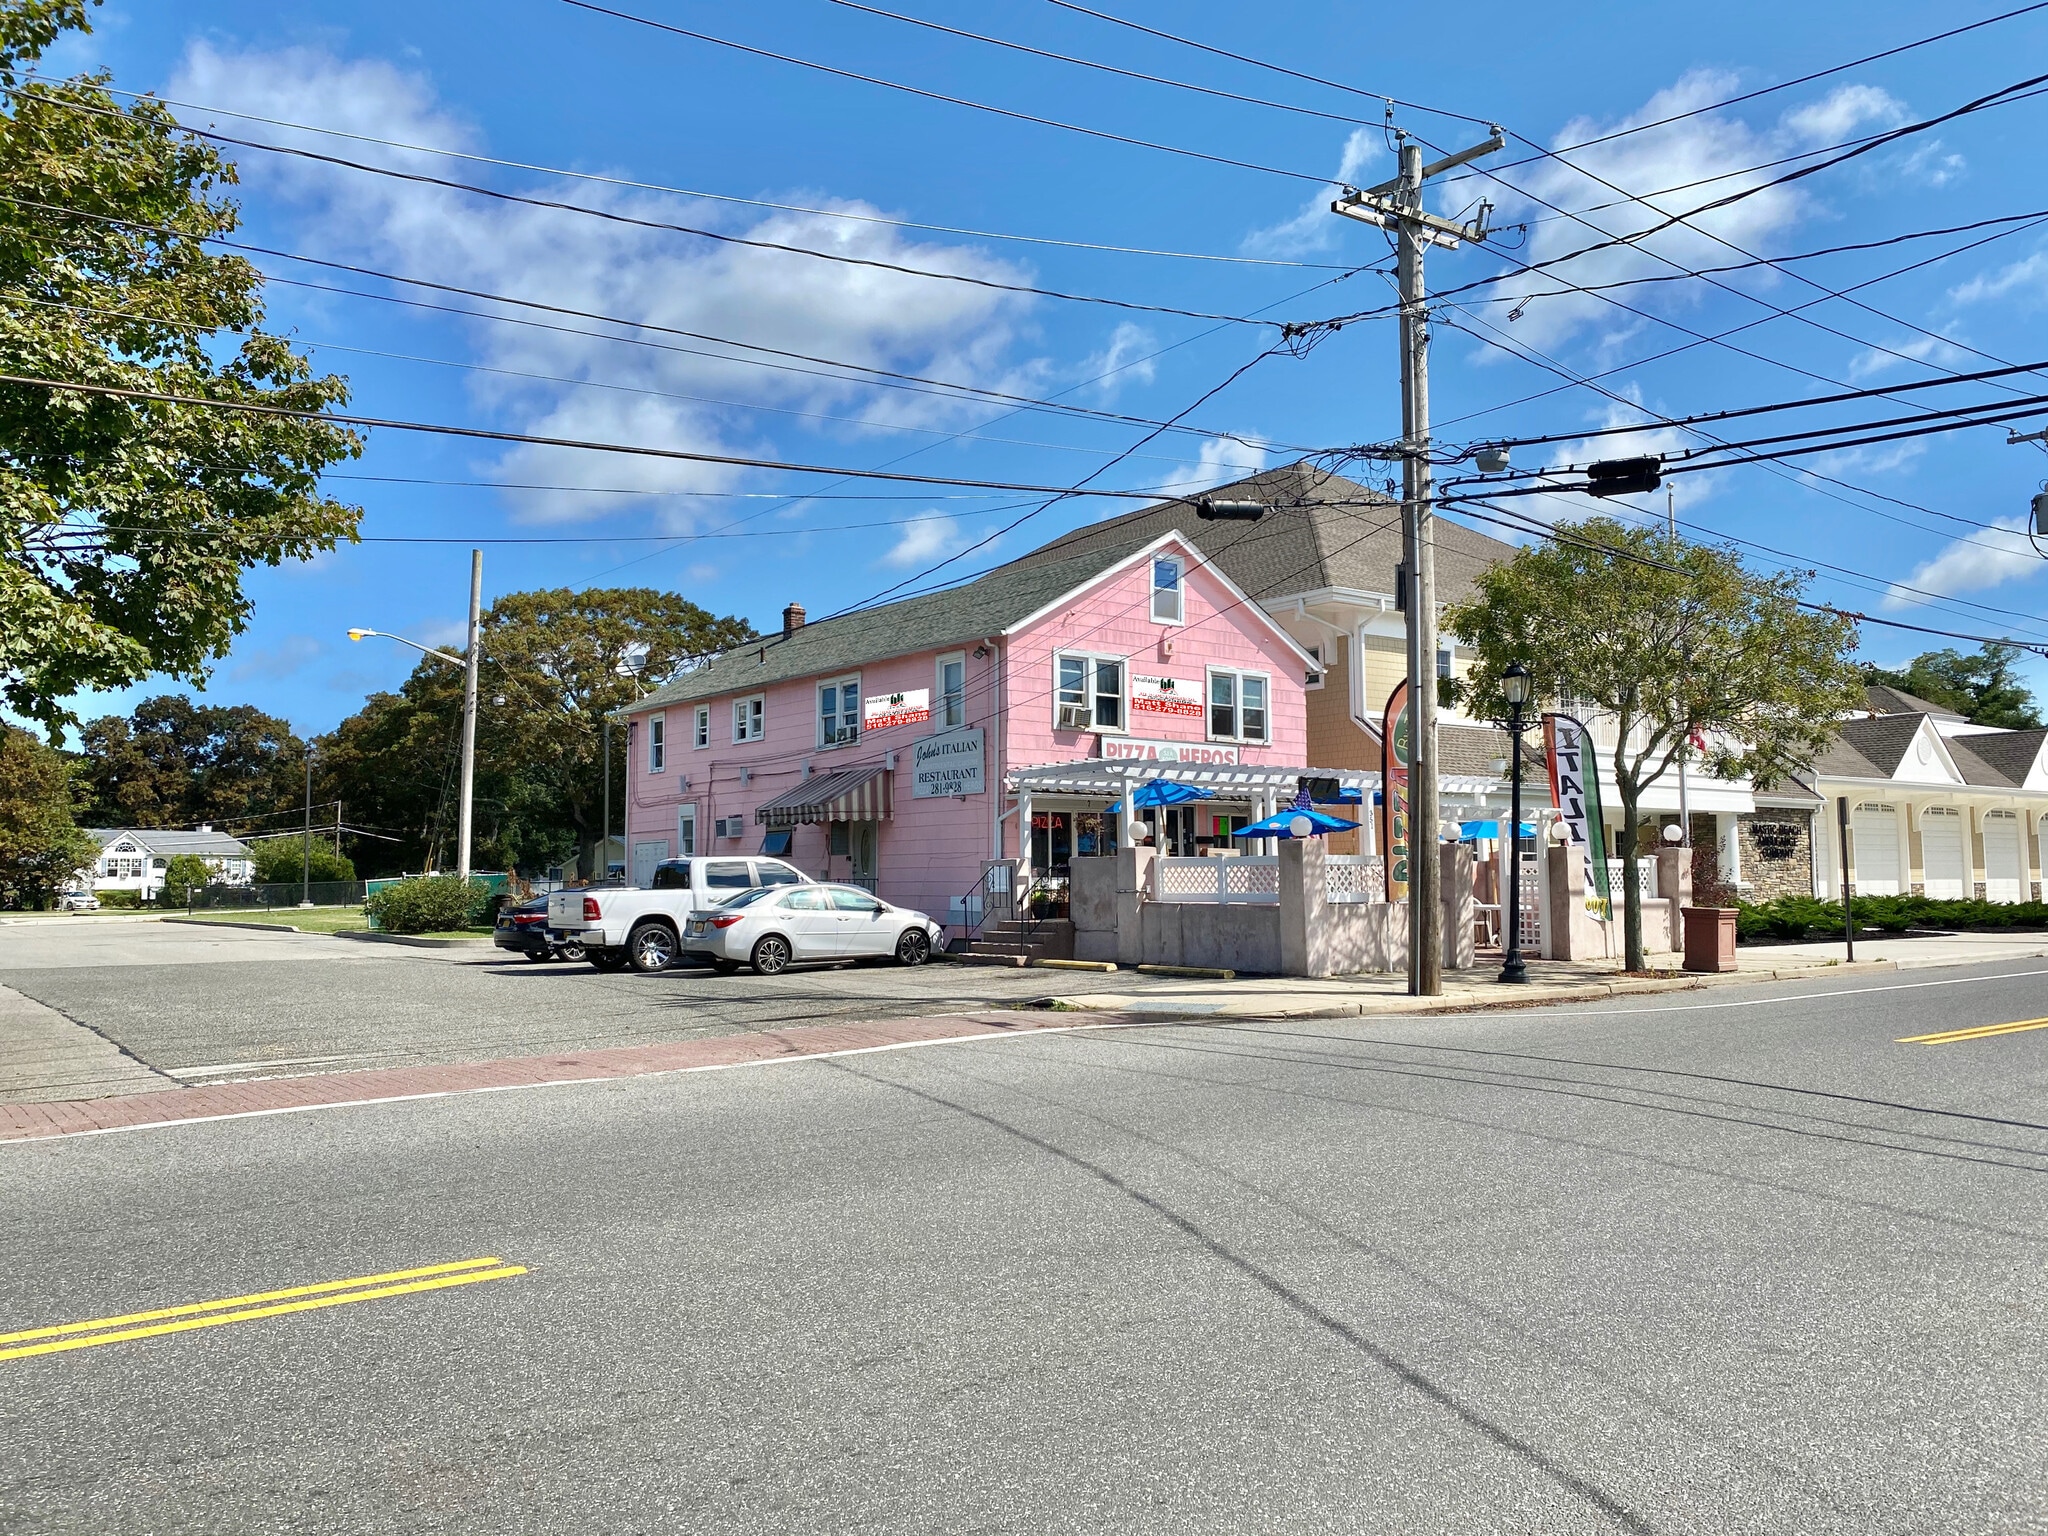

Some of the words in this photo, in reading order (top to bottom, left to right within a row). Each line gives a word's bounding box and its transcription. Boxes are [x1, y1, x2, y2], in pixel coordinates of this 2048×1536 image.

[1132, 676, 1160, 684] Available
[1134, 698, 1161, 707] Matt
[1165, 701, 1201, 711] Shane
[866, 716, 892, 725] Matt
[895, 711, 928, 721] Shane
[916, 741, 941, 768] John's
[942, 740, 978, 755] ITALIAN
[1106, 742, 1157, 760] PIZZA
[1179, 747, 1235, 765] HEROS
[918, 767, 978, 783] RESTAURANT
